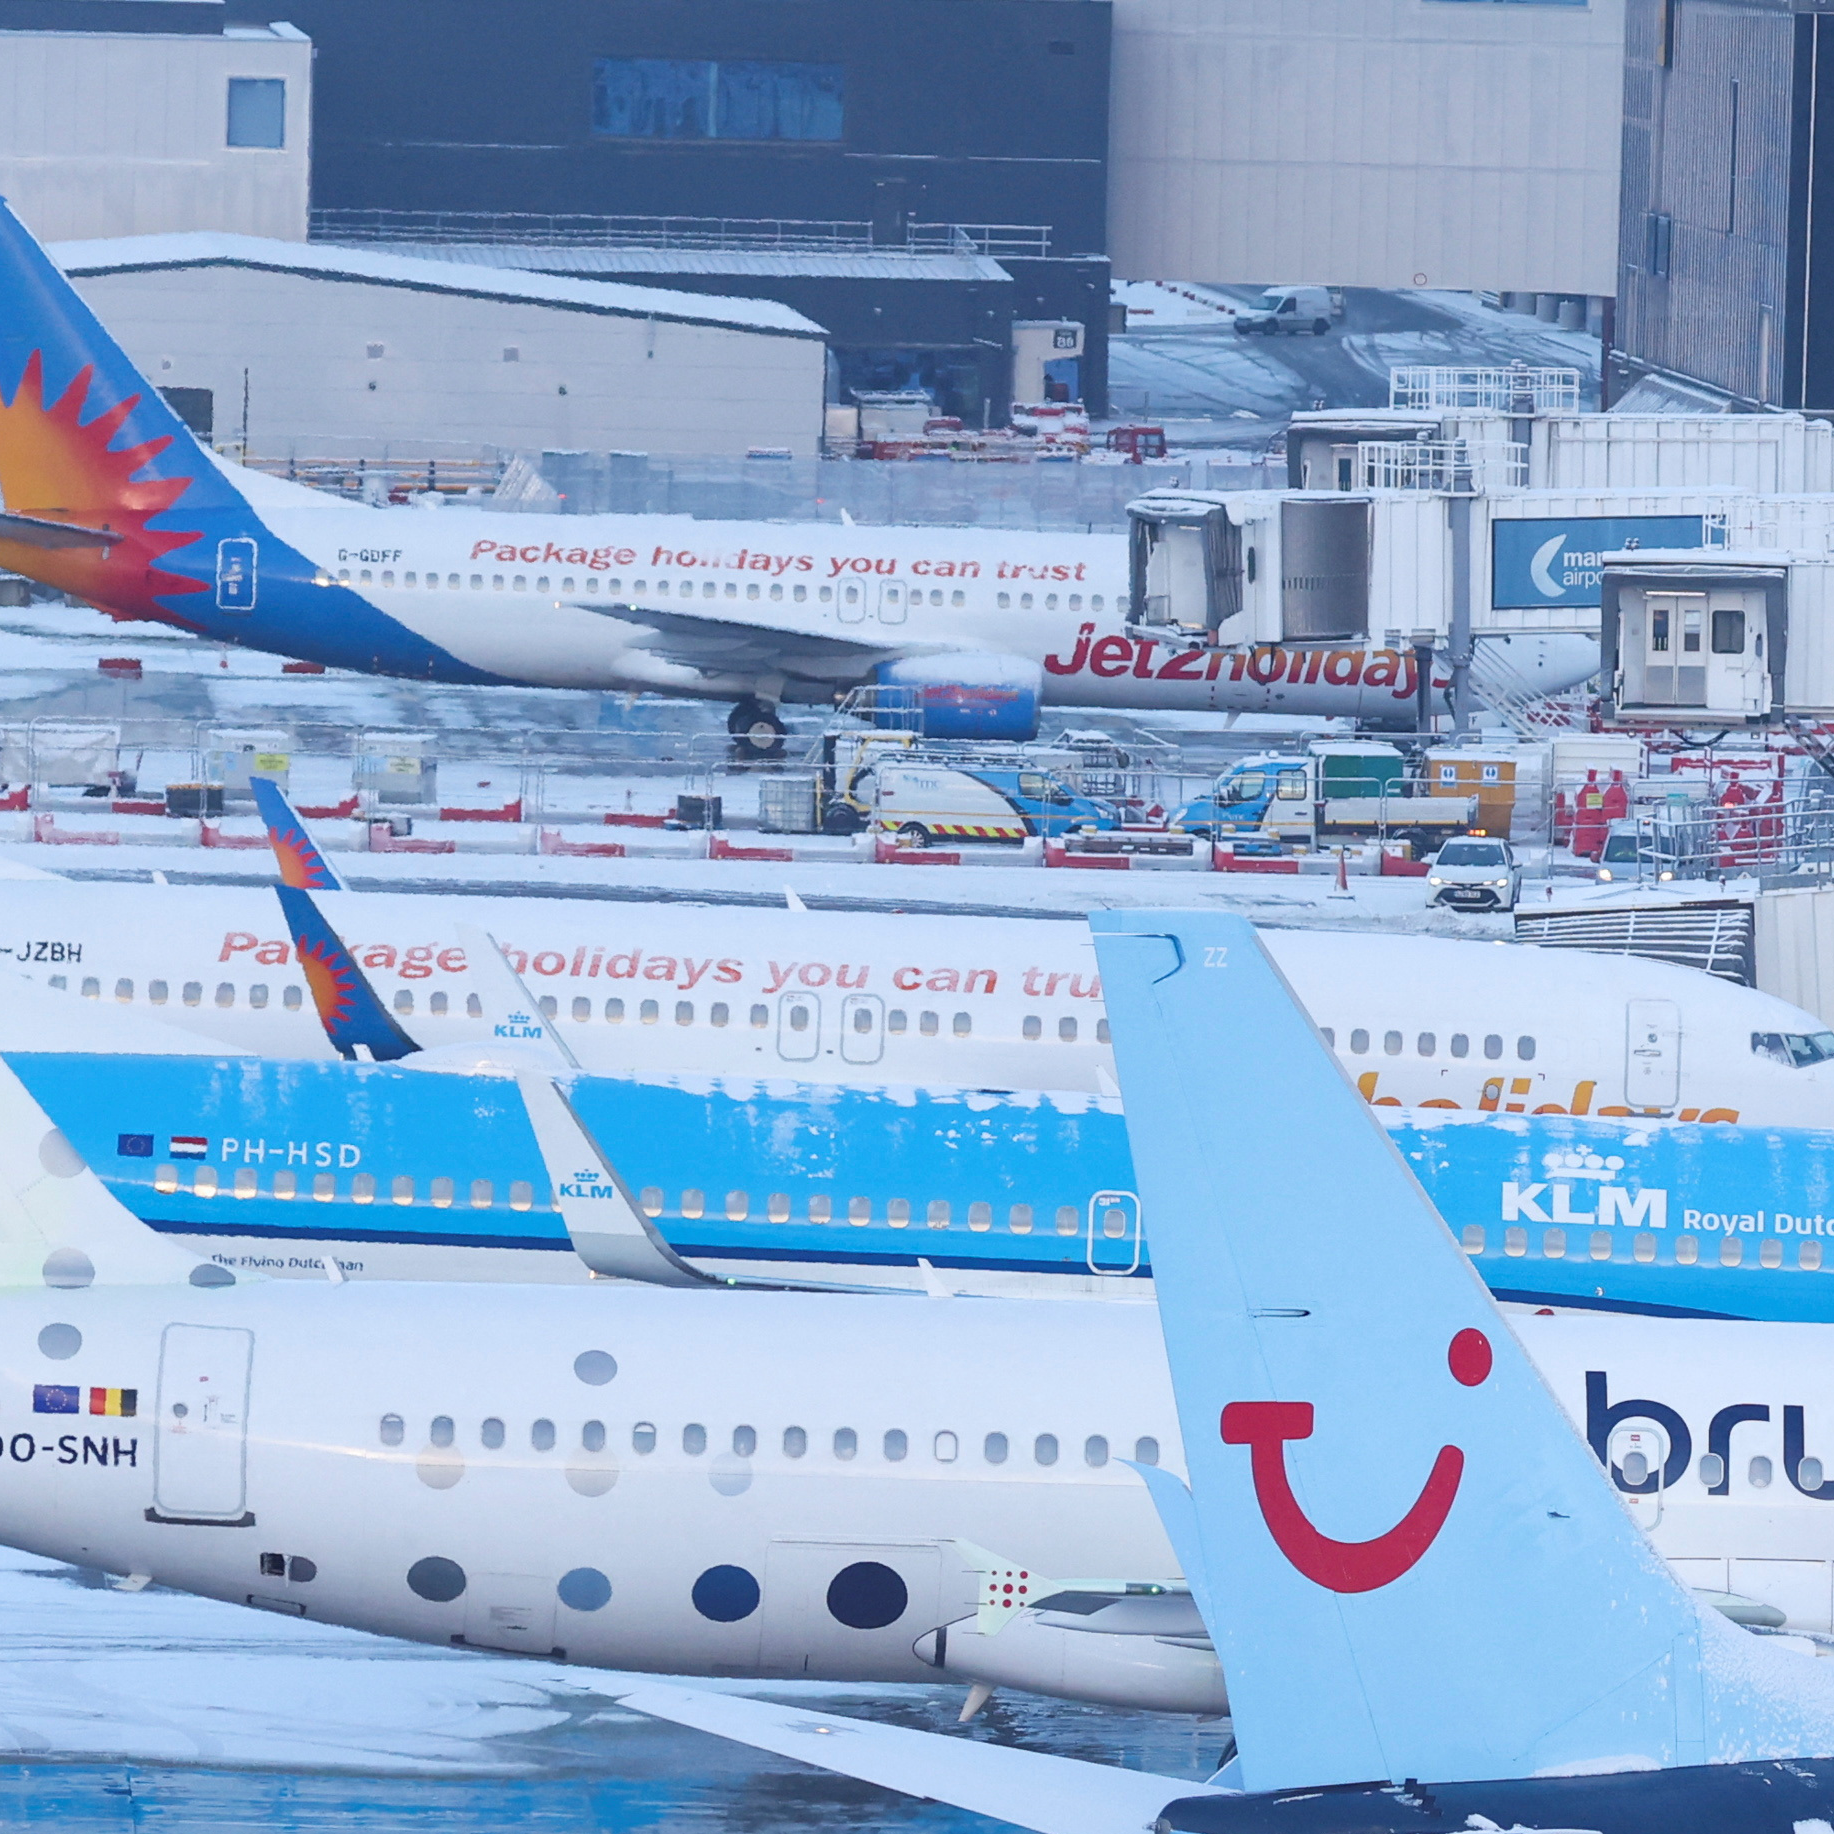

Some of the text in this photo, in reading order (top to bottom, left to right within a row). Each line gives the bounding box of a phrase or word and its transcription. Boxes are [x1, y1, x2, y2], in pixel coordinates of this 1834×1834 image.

[469, 539, 637, 571] Package
[827, 555, 897, 578] you
[911, 560, 981, 580] can
[997, 559, 1086, 582] trust
[500, 944, 744, 989] holidays
[761, 958, 869, 995] you
[892, 966, 998, 995] can
[1204, 946, 1228, 968] ZZ
[494, 1024, 543, 1040] KLM
[220, 1137, 363, 1169] PH-HSD
[559, 1183, 615, 1200] KLM
[1501, 1181, 1667, 1230] KLM
[1683, 1208, 1765, 1238] Royal
